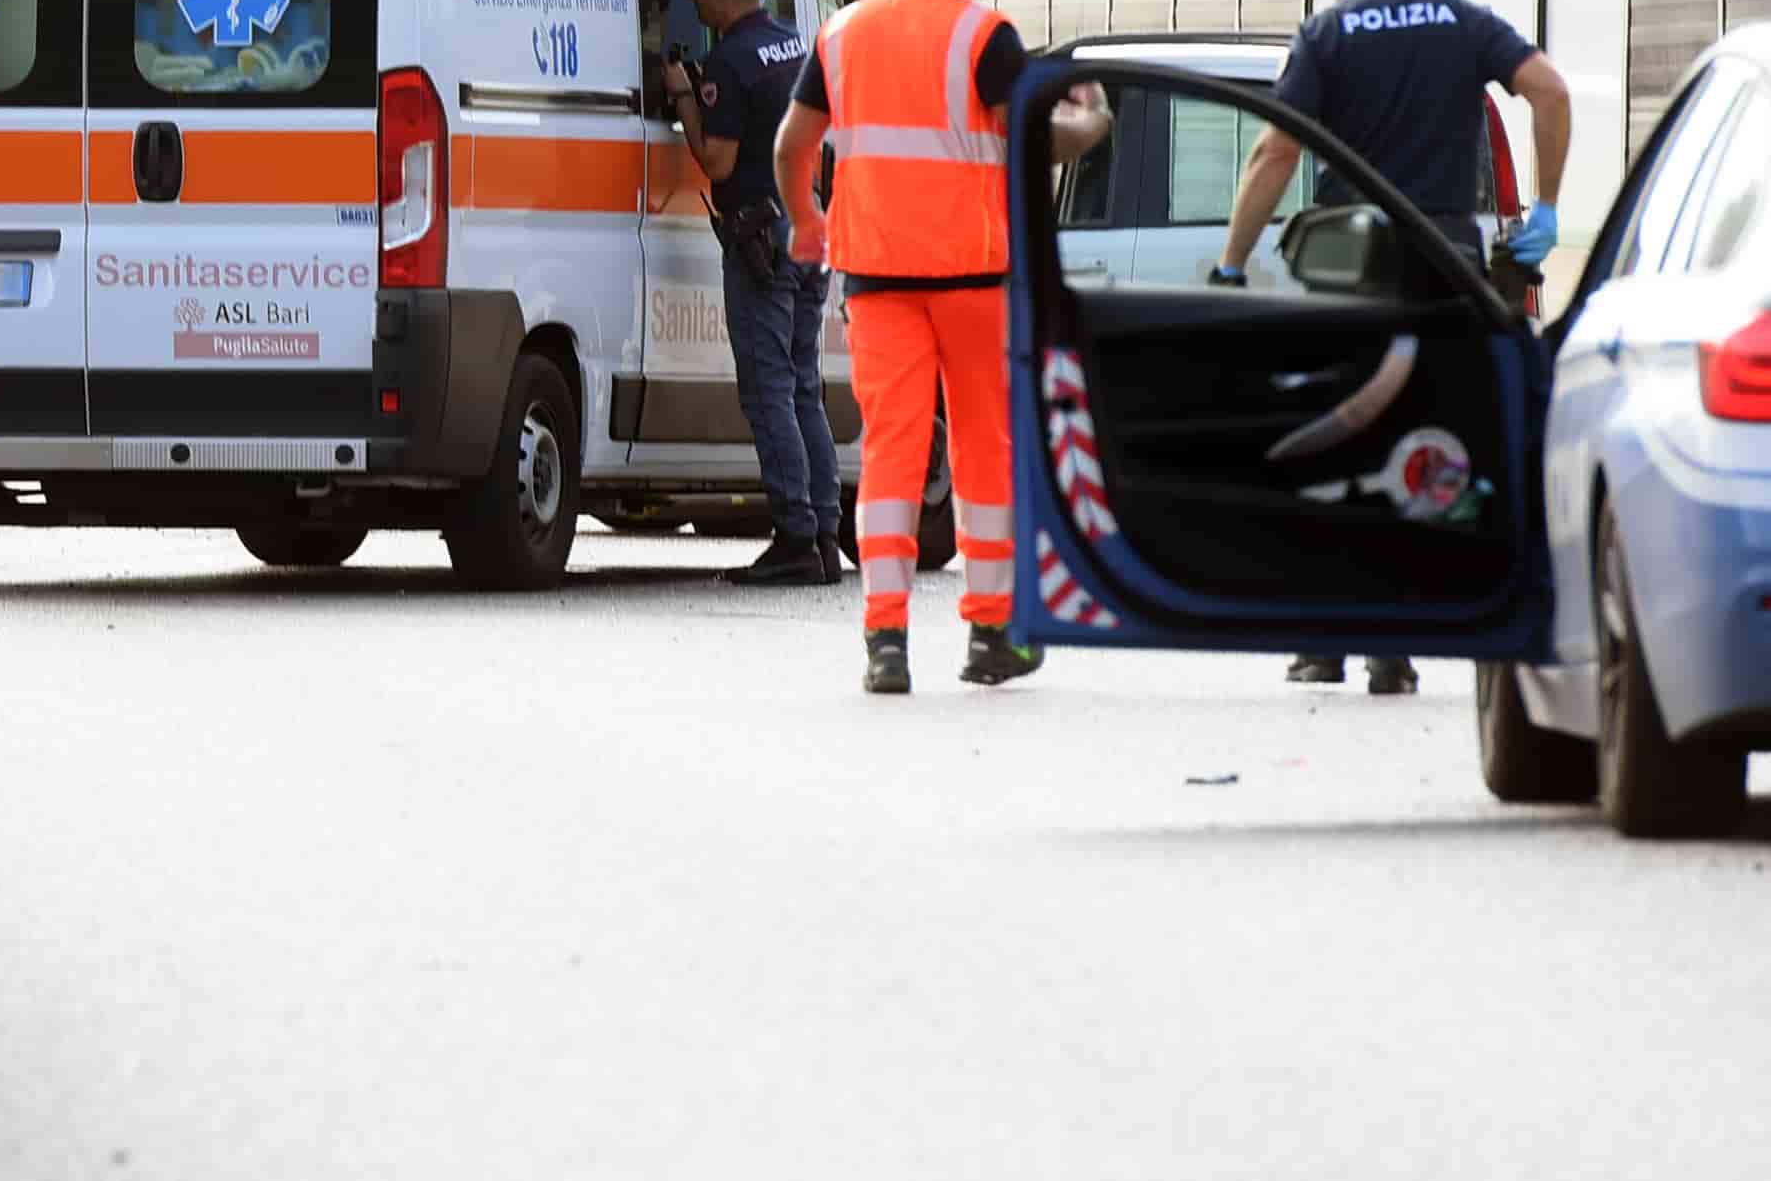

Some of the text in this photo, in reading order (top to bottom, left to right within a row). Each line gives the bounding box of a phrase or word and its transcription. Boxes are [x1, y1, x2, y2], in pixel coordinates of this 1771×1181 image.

[1343, 2, 1457, 34] POLIZIA
[549, 21, 578, 77] 118
[95, 253, 370, 288] Sanitaservice
[214, 302, 311, 324] ASL Bari
[651, 289, 728, 342] Sanitas
